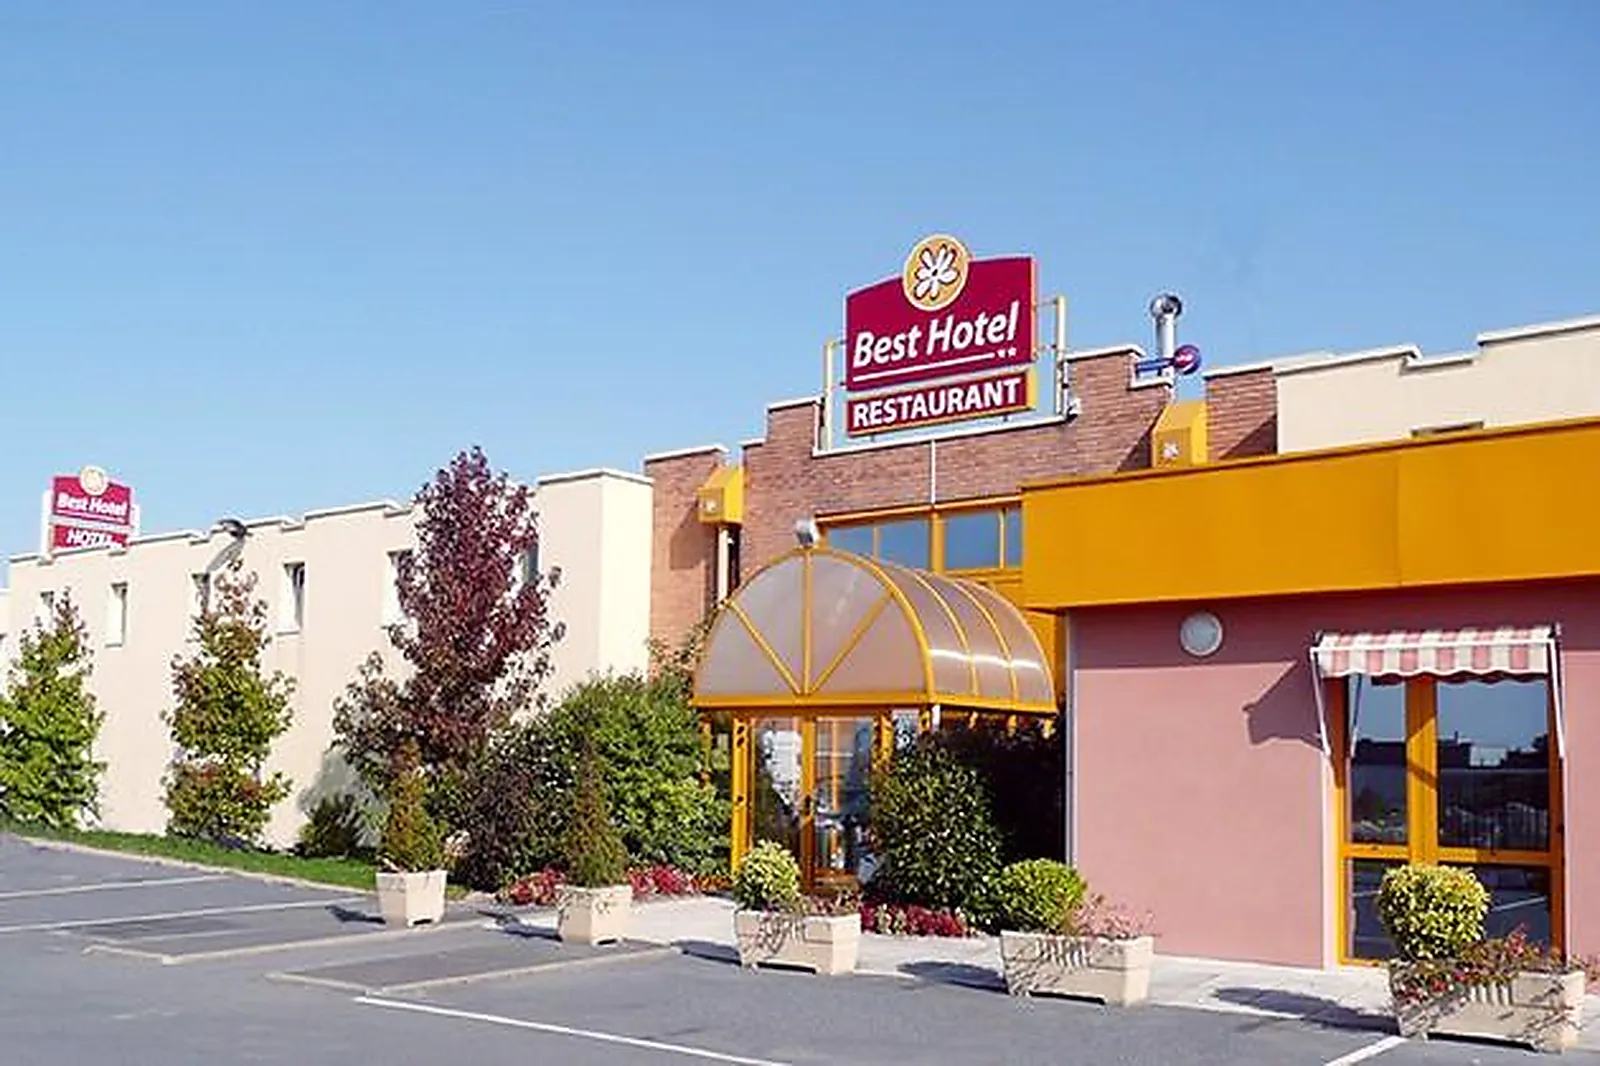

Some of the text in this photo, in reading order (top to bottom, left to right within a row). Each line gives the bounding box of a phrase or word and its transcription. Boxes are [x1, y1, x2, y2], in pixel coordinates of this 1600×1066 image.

[852, 300, 1019, 368] Best Hotel
[853, 378, 1021, 428] RESTAURANT
[57, 492, 127, 516] Best Hotel
